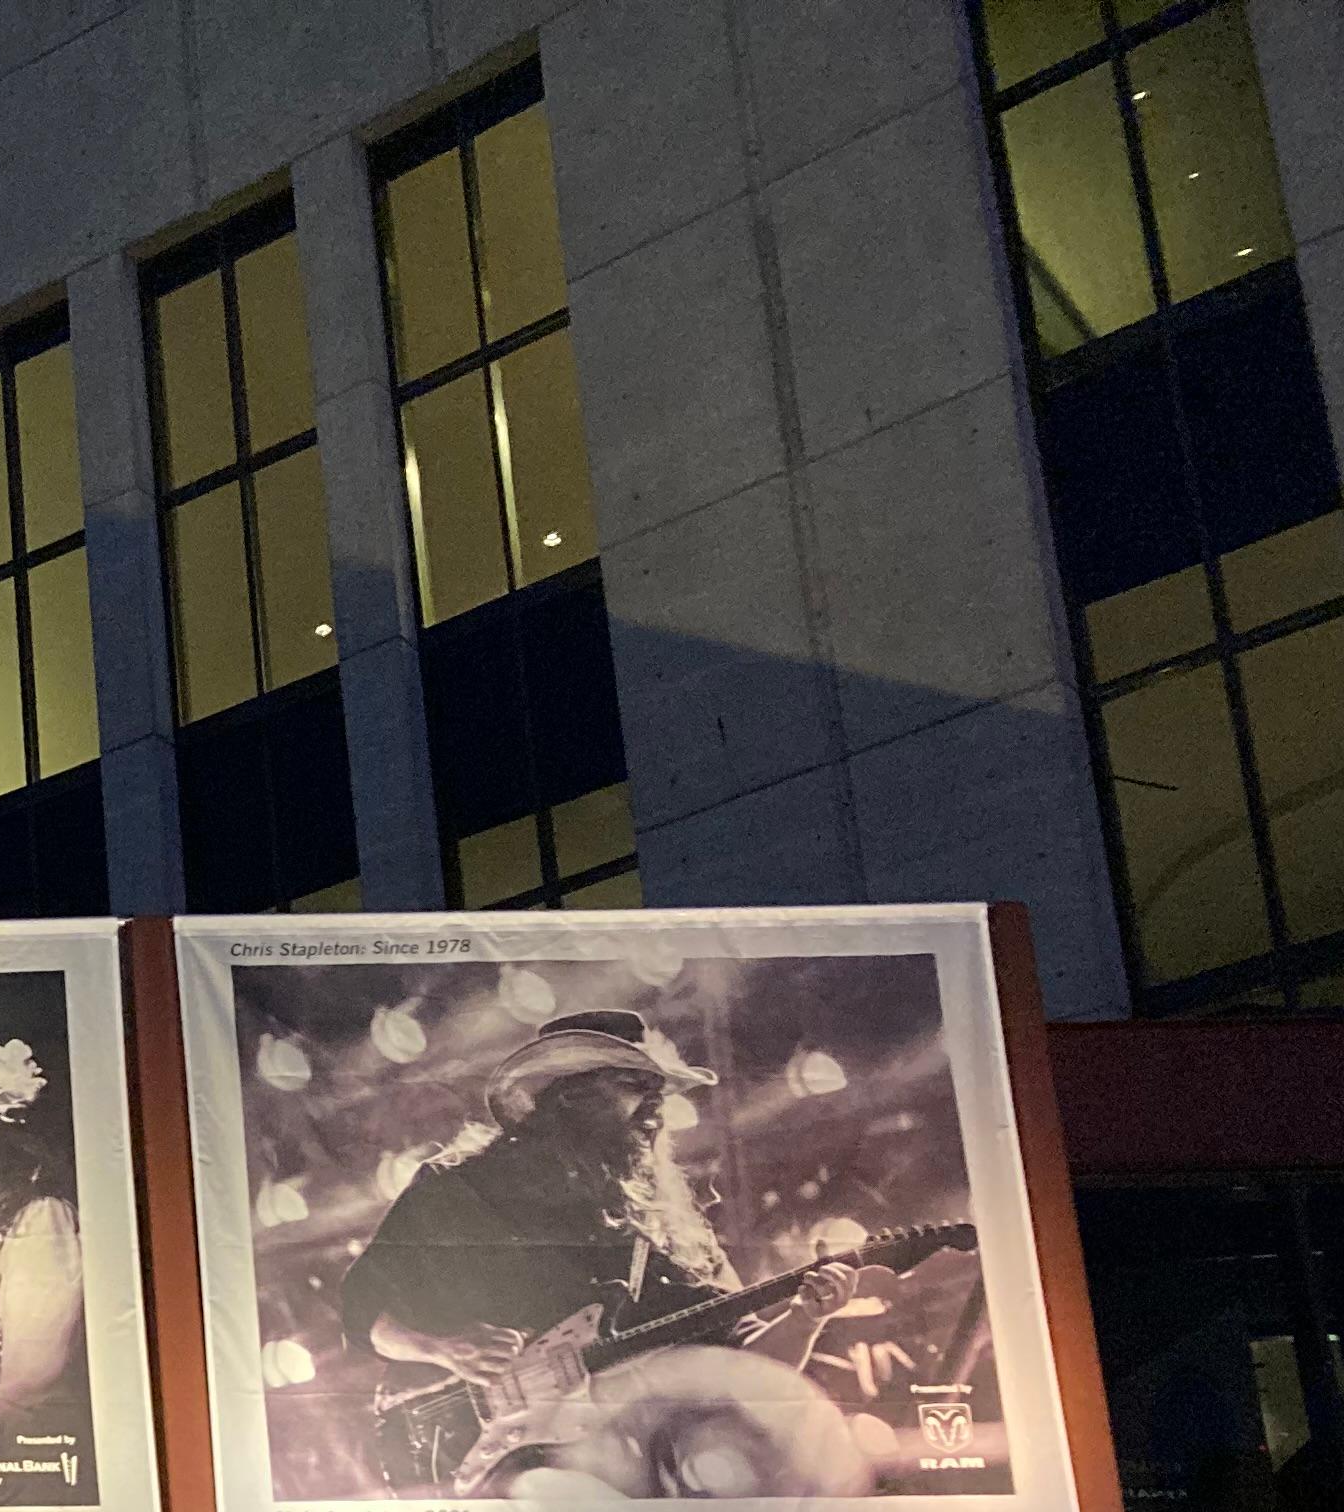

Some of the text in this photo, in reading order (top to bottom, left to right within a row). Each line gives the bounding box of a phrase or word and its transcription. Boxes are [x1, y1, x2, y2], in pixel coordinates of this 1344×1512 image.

[230, 938, 471, 959] Chris Stapleton: Since 1978
[920, 1457, 985, 1469] RAM
